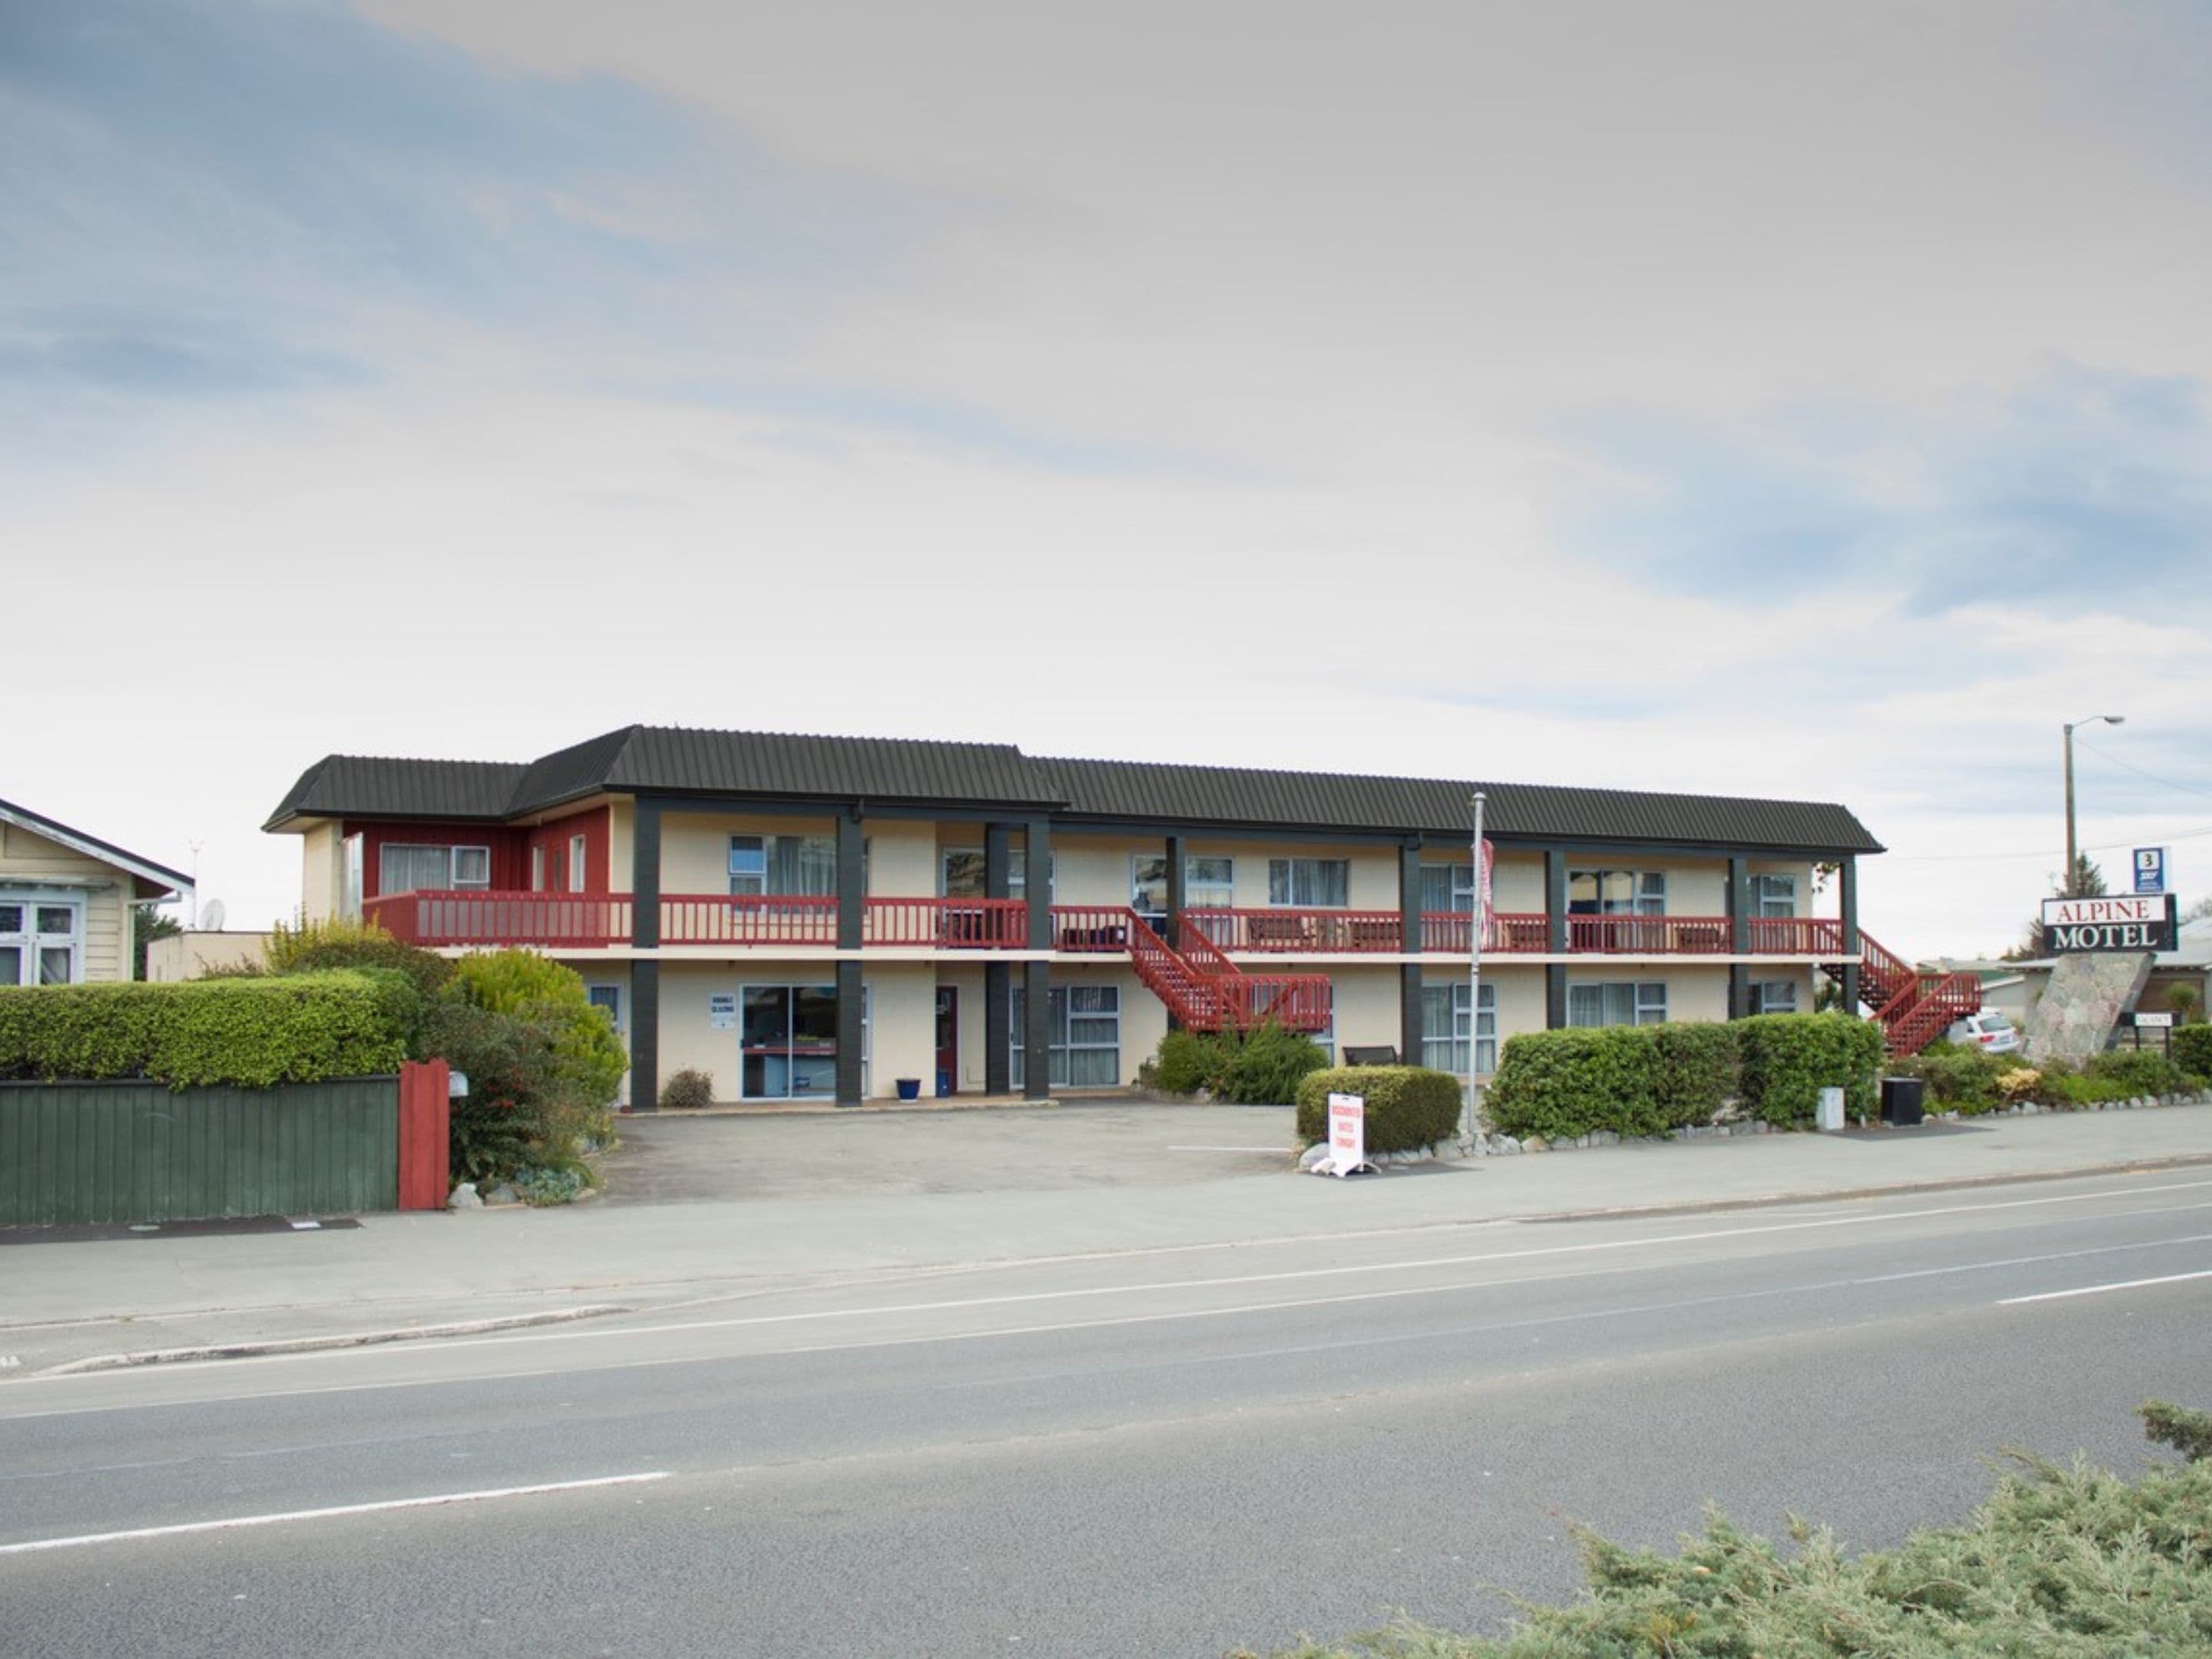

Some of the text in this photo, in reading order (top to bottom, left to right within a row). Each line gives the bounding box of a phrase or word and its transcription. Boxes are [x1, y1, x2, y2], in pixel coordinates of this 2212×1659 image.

[2144, 853, 2154, 867] 3
[2057, 899, 2151, 922] ALPINE
[2053, 923, 2158, 949] MOTEL
